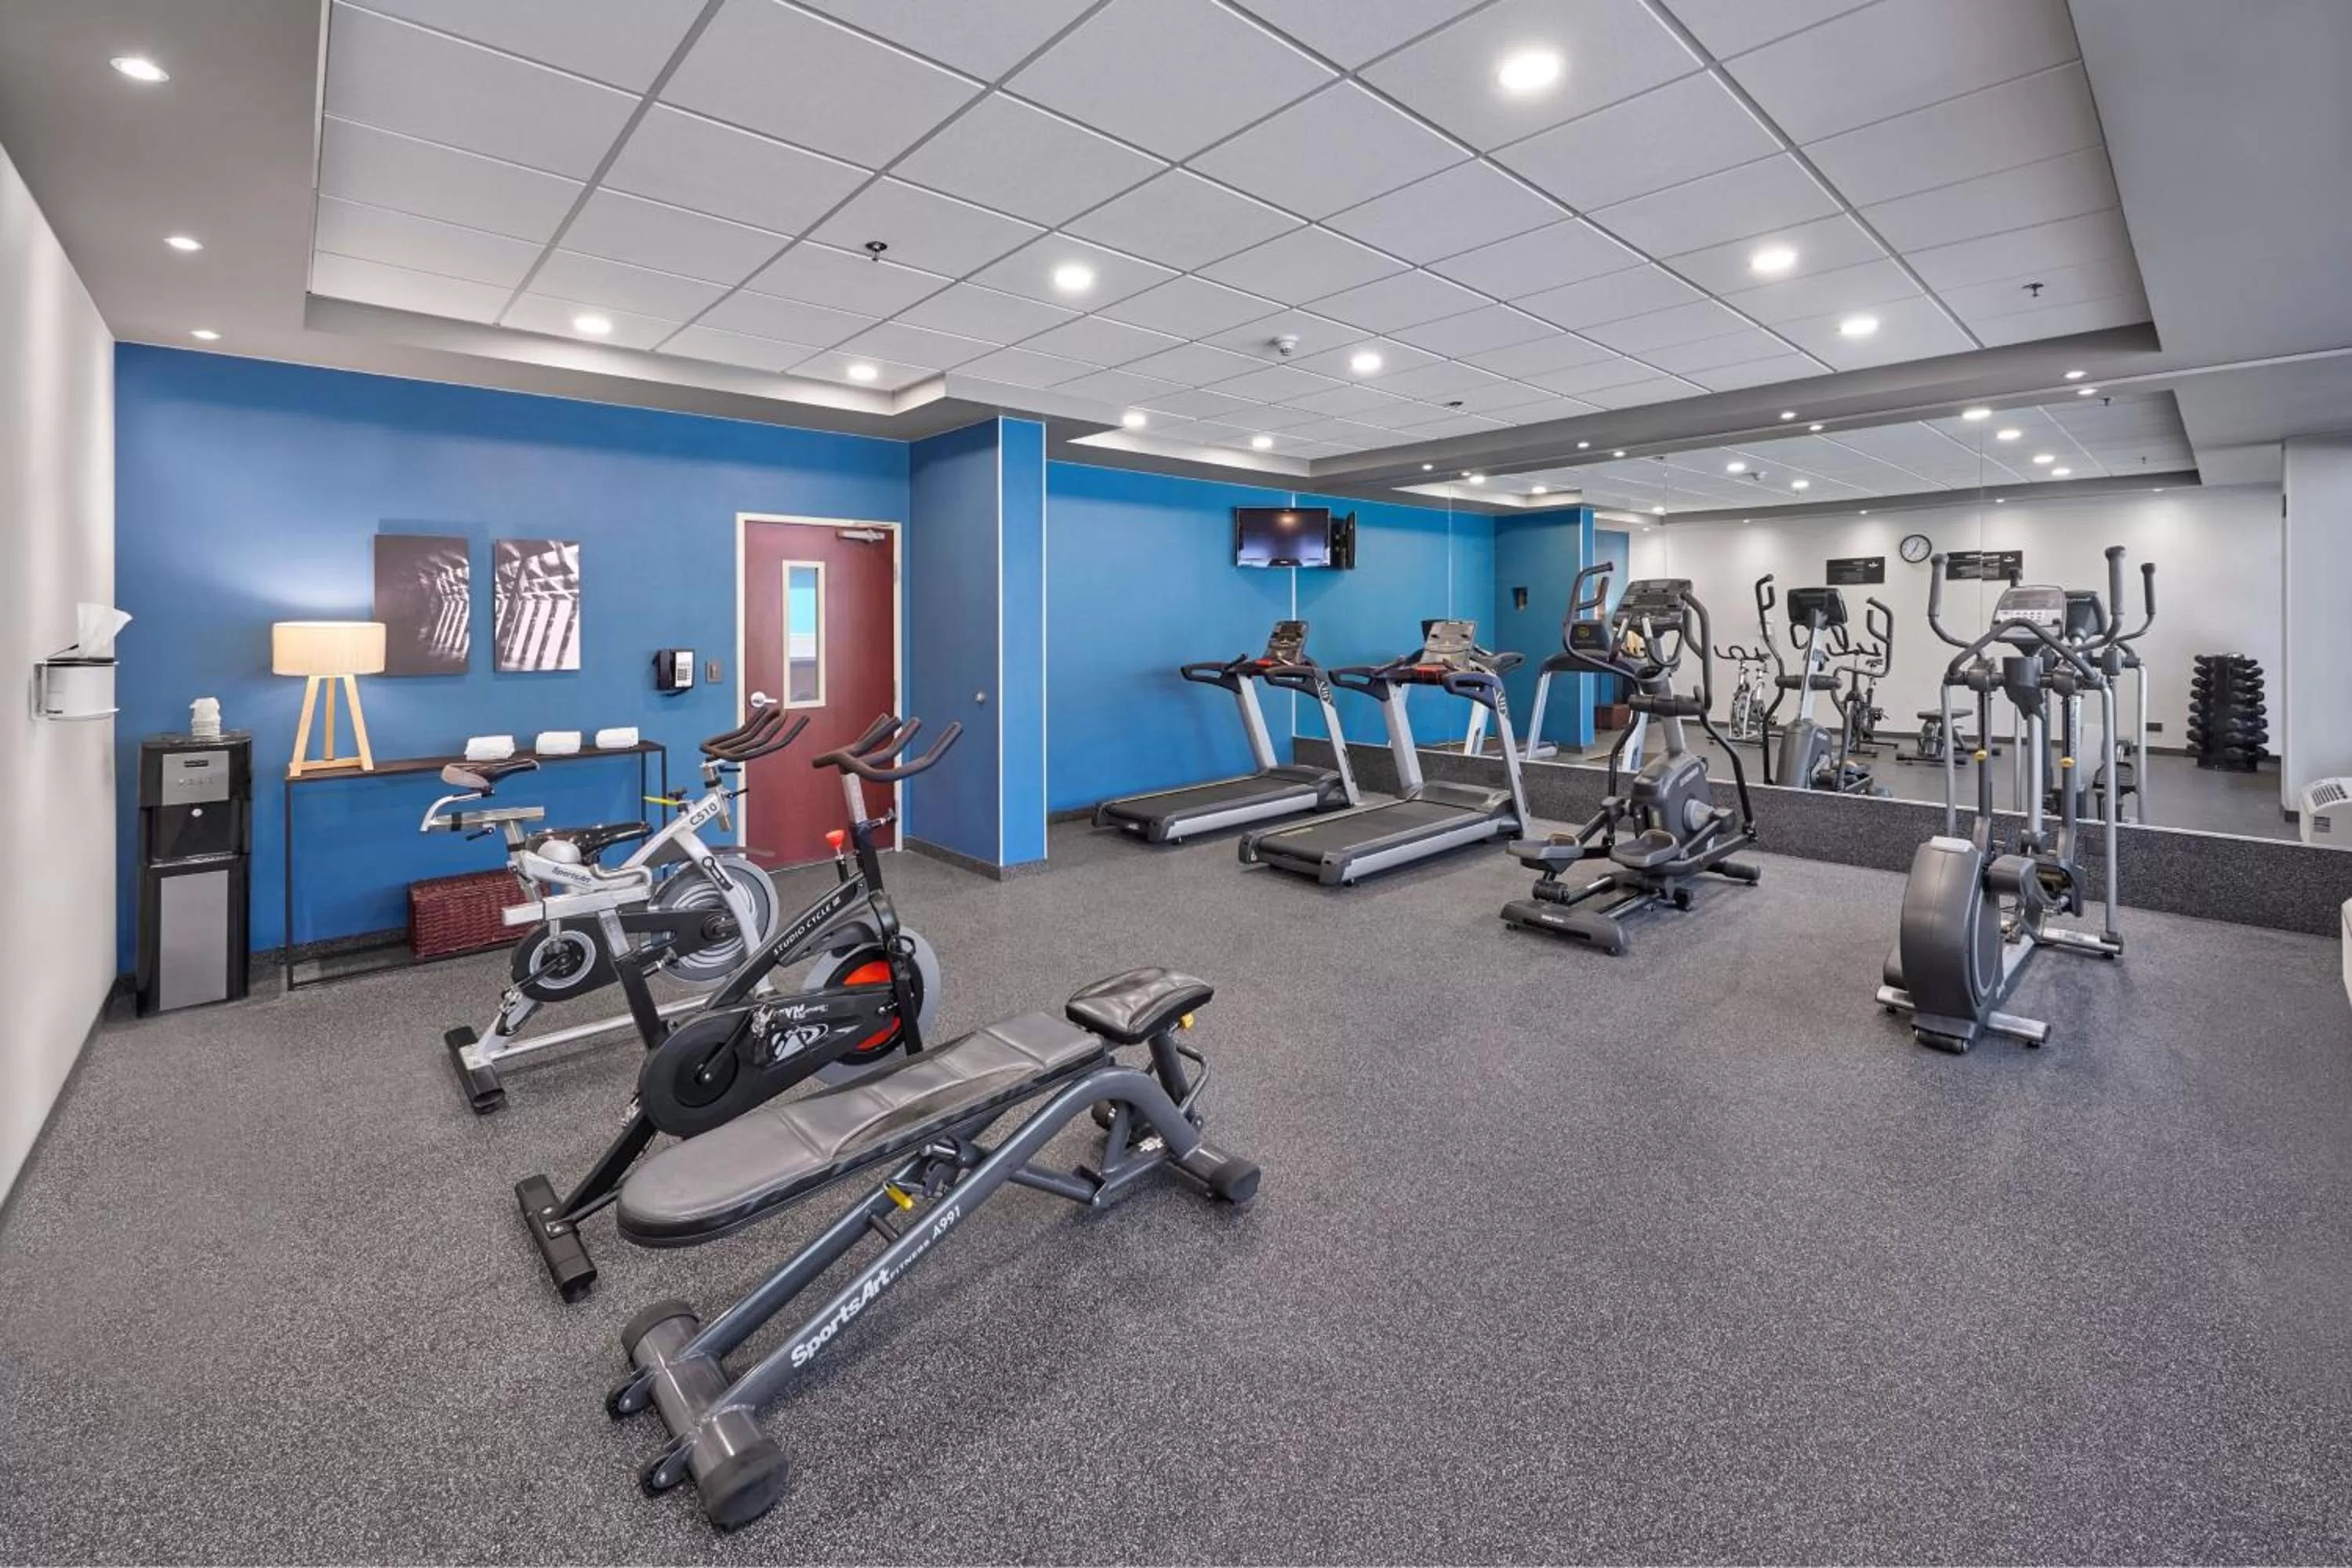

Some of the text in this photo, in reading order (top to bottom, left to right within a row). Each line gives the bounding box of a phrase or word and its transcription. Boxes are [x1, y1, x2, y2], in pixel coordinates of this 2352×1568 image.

[773, 902, 831, 956] STUDIO CYCLE
[790, 1266, 891, 1367] SportsArt
[931, 1204, 960, 1240] A991
